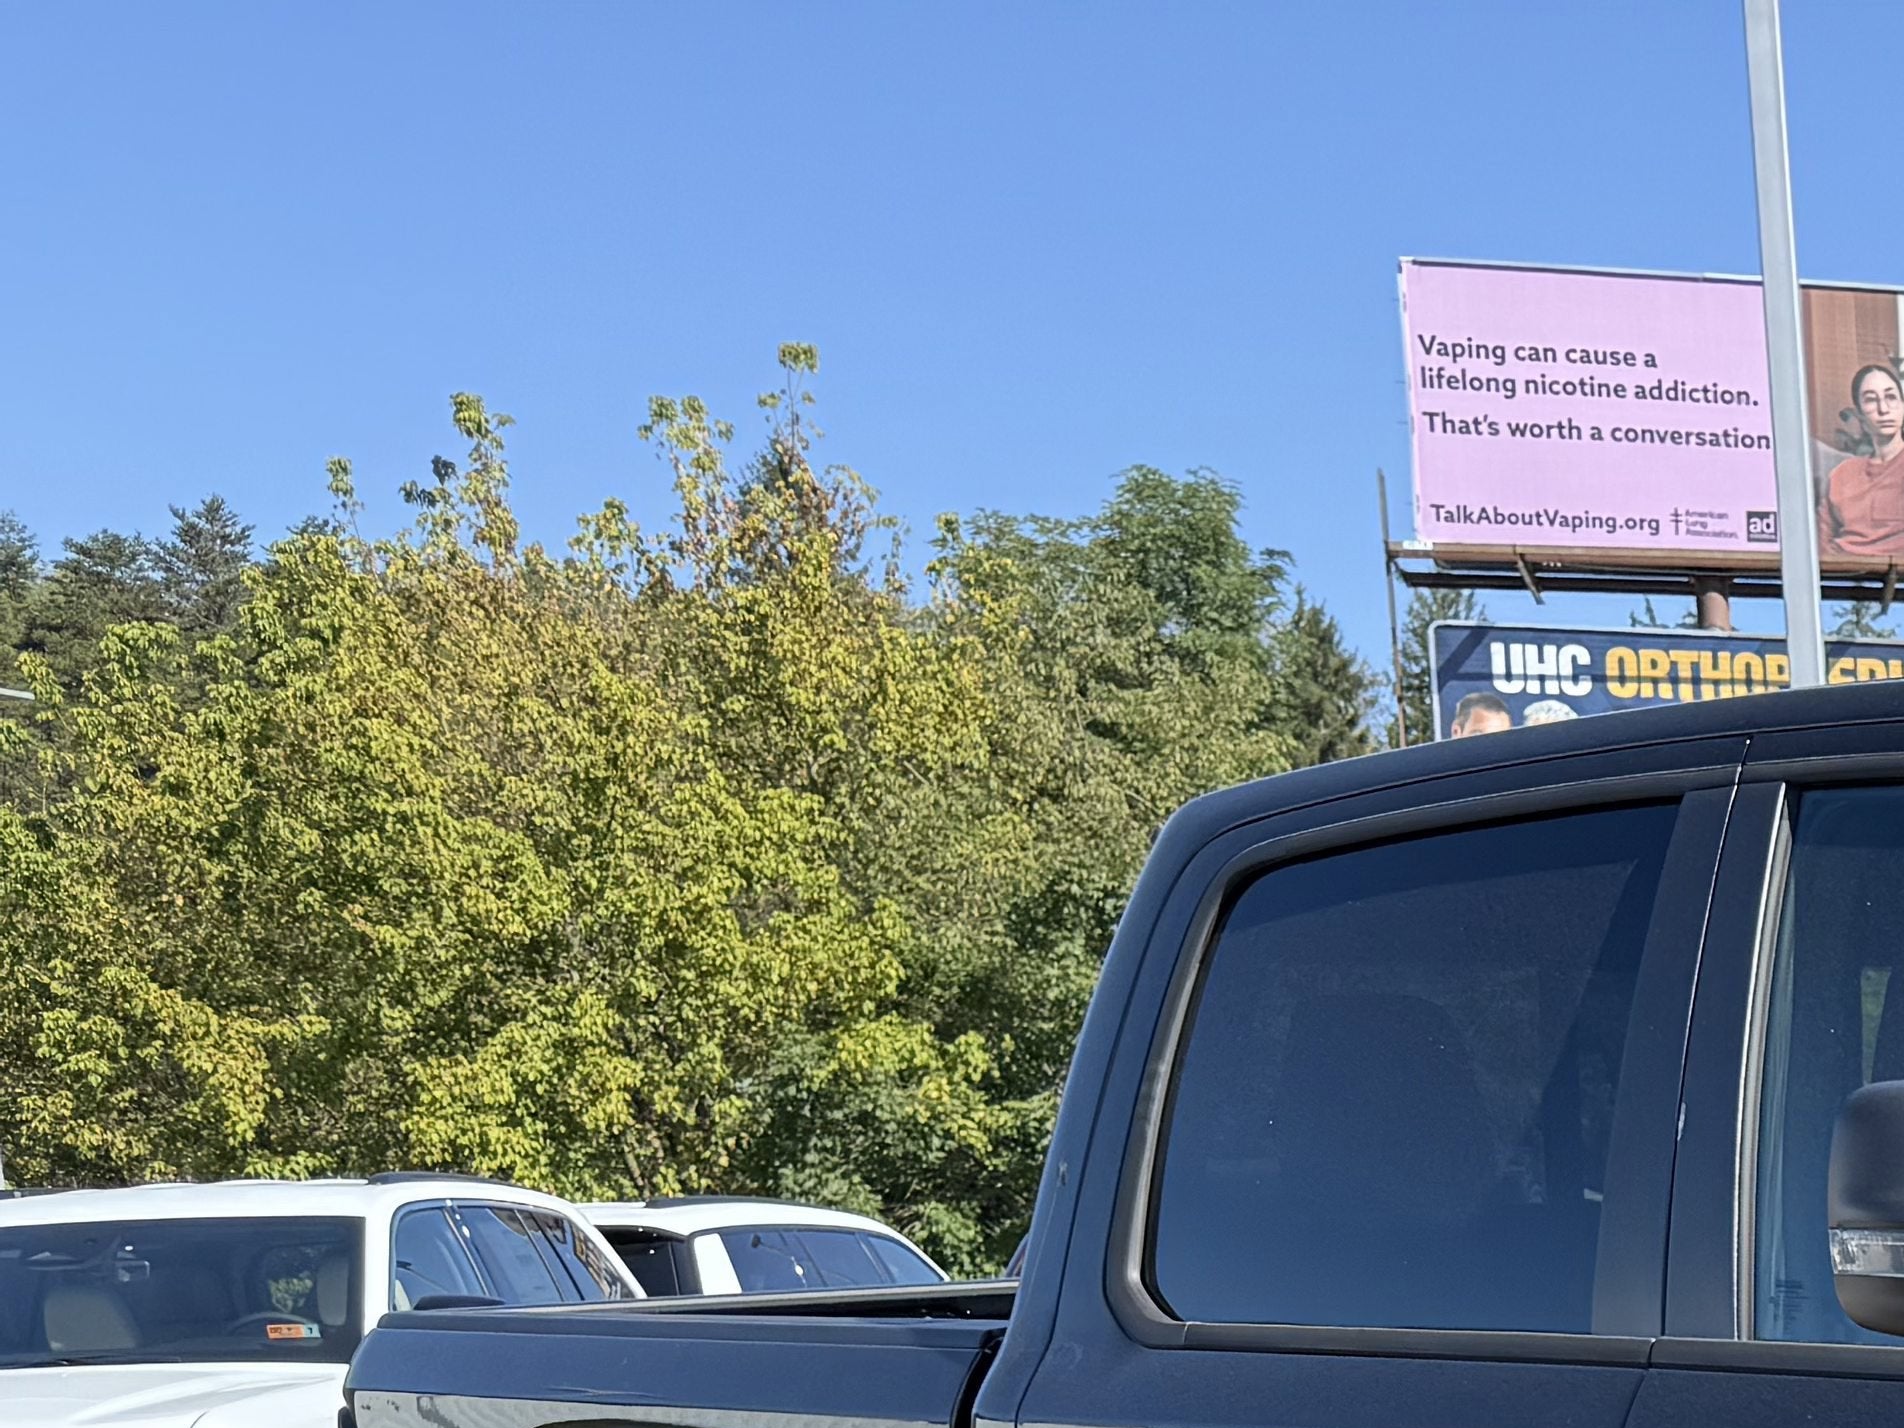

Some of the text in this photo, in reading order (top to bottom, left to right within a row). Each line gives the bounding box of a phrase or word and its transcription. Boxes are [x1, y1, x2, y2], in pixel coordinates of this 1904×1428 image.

[1417, 333, 1658, 369] Vaping can cause a
[1420, 365, 1759, 407] lifelong nicotine addiction.
[1421, 410, 1771, 450] That's worth a conversation
[1429, 503, 1661, 537] TalkAboutVaping.org
[1748, 512, 1776, 534] ad
[1490, 641, 1594, 697] UHC
